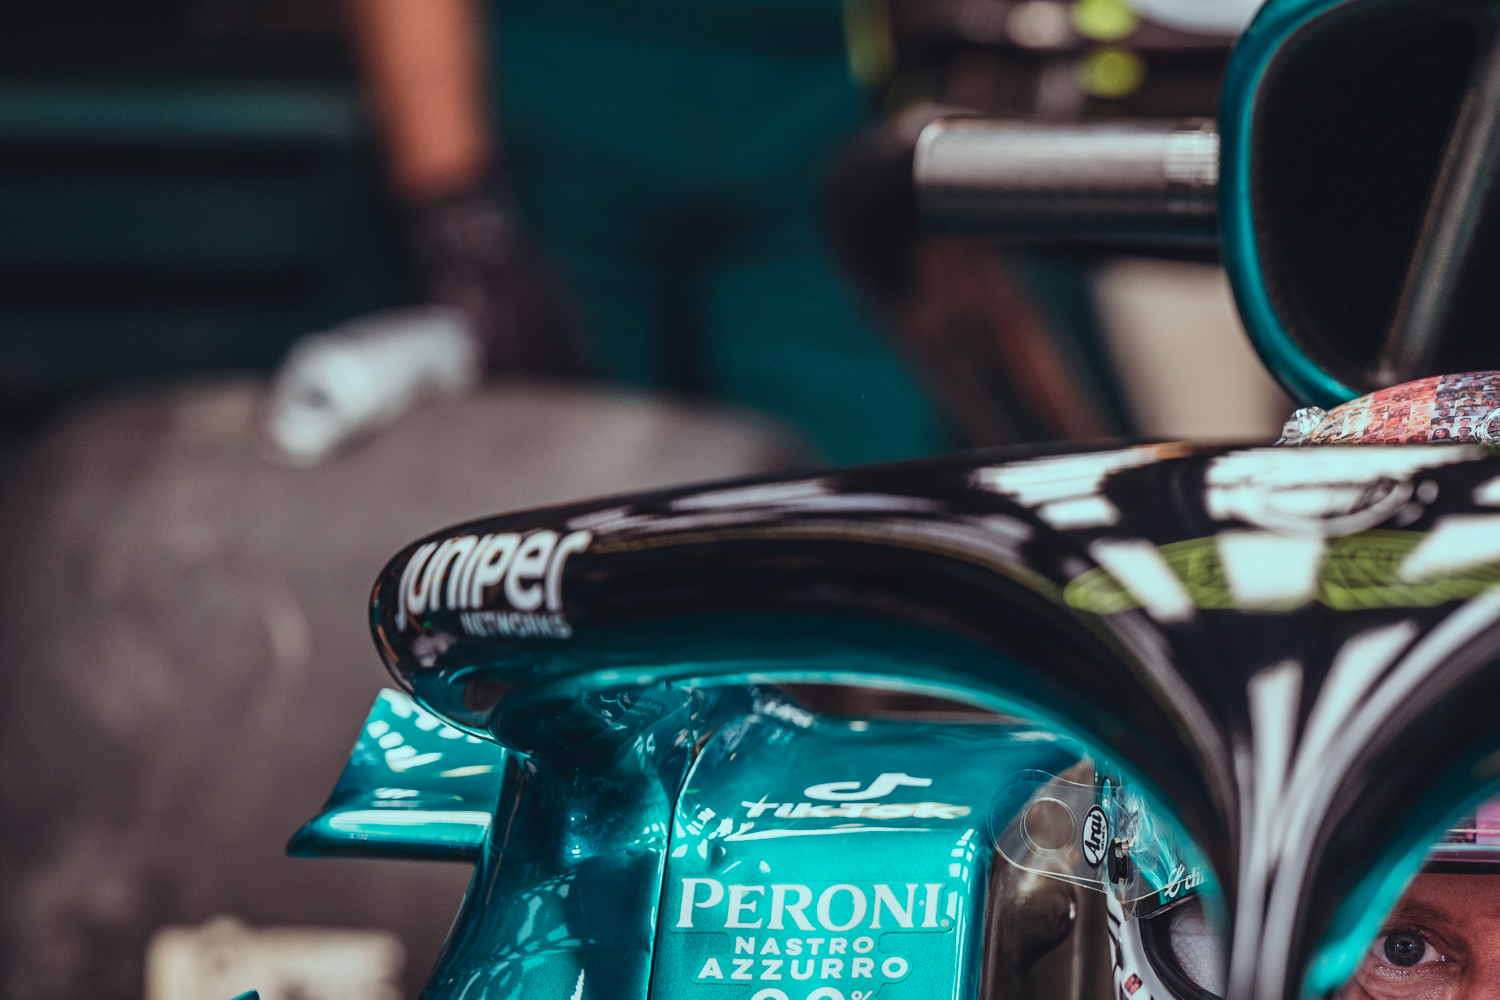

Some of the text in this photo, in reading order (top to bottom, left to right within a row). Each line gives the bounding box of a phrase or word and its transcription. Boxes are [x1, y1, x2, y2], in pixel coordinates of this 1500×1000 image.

[741, 801, 972, 819] TikTok
[1084, 811, 1102, 863] Arai
[676, 877, 947, 931] PERONI
[735, 936, 874, 955] NASTRO
[698, 957, 909, 980] AZZURRO
